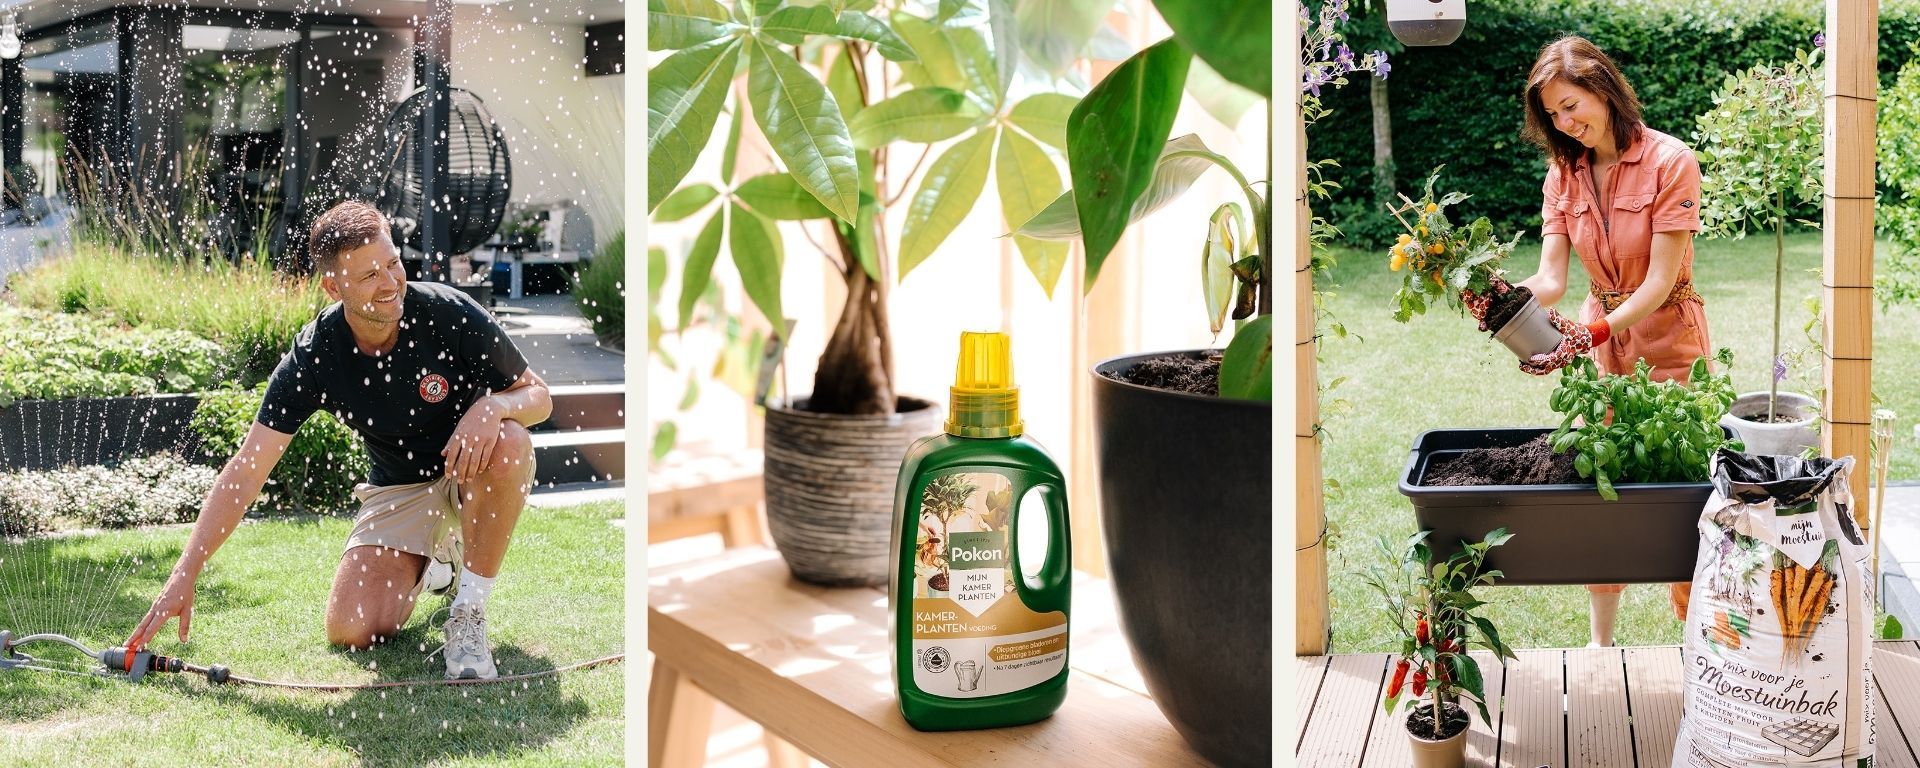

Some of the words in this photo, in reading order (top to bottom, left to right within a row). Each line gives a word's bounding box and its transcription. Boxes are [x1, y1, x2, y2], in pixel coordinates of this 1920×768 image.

[1790, 520, 1813, 533] mijn
[951, 546, 1002, 562] Pokon
[966, 574, 988, 582] MIJN
[962, 583, 992, 591] KAMER
[958, 592, 996, 601] PLANTEN
[916, 611, 958, 622] KAMER-
[916, 623, 967, 634] PLANTEN
[968, 624, 997, 632] VOEDING
[996, 651, 1028, 661] uitbundige
[1722, 659, 1748, 677] mix
[1751, 670, 1785, 685] voor
[1784, 674, 1805, 692] je
[1696, 655, 1839, 718] Moestuinbak
[1696, 687, 1732, 709] COMPLETE
[1734, 704, 1749, 715] MIX
[1751, 711, 1774, 723] VOOR
[1700, 705, 1734, 726] KRUIDEN
[1736, 714, 1761, 728] FRUIT
